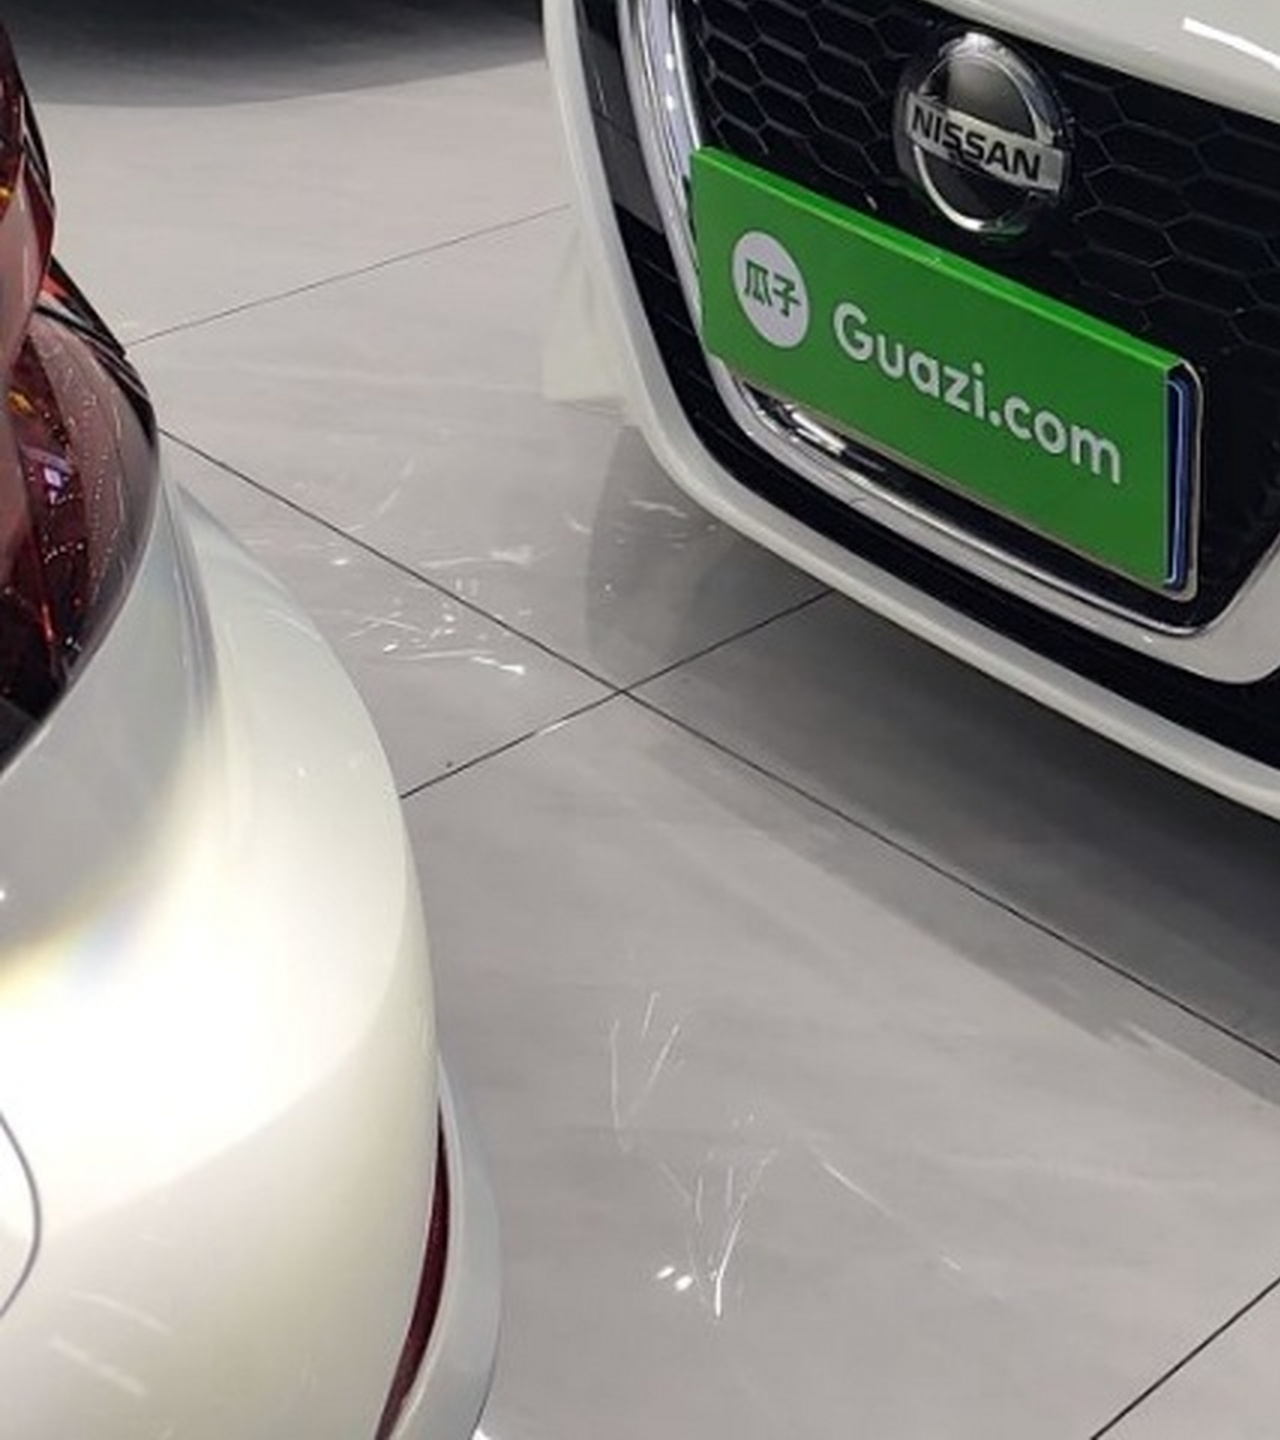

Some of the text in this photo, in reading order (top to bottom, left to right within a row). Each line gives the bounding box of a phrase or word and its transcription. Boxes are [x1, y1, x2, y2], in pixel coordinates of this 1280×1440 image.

[911, 106, 1041, 182] NISSAN
[743, 259, 802, 318] 瓜子
[833, 301, 1122, 485] Guazi.com
